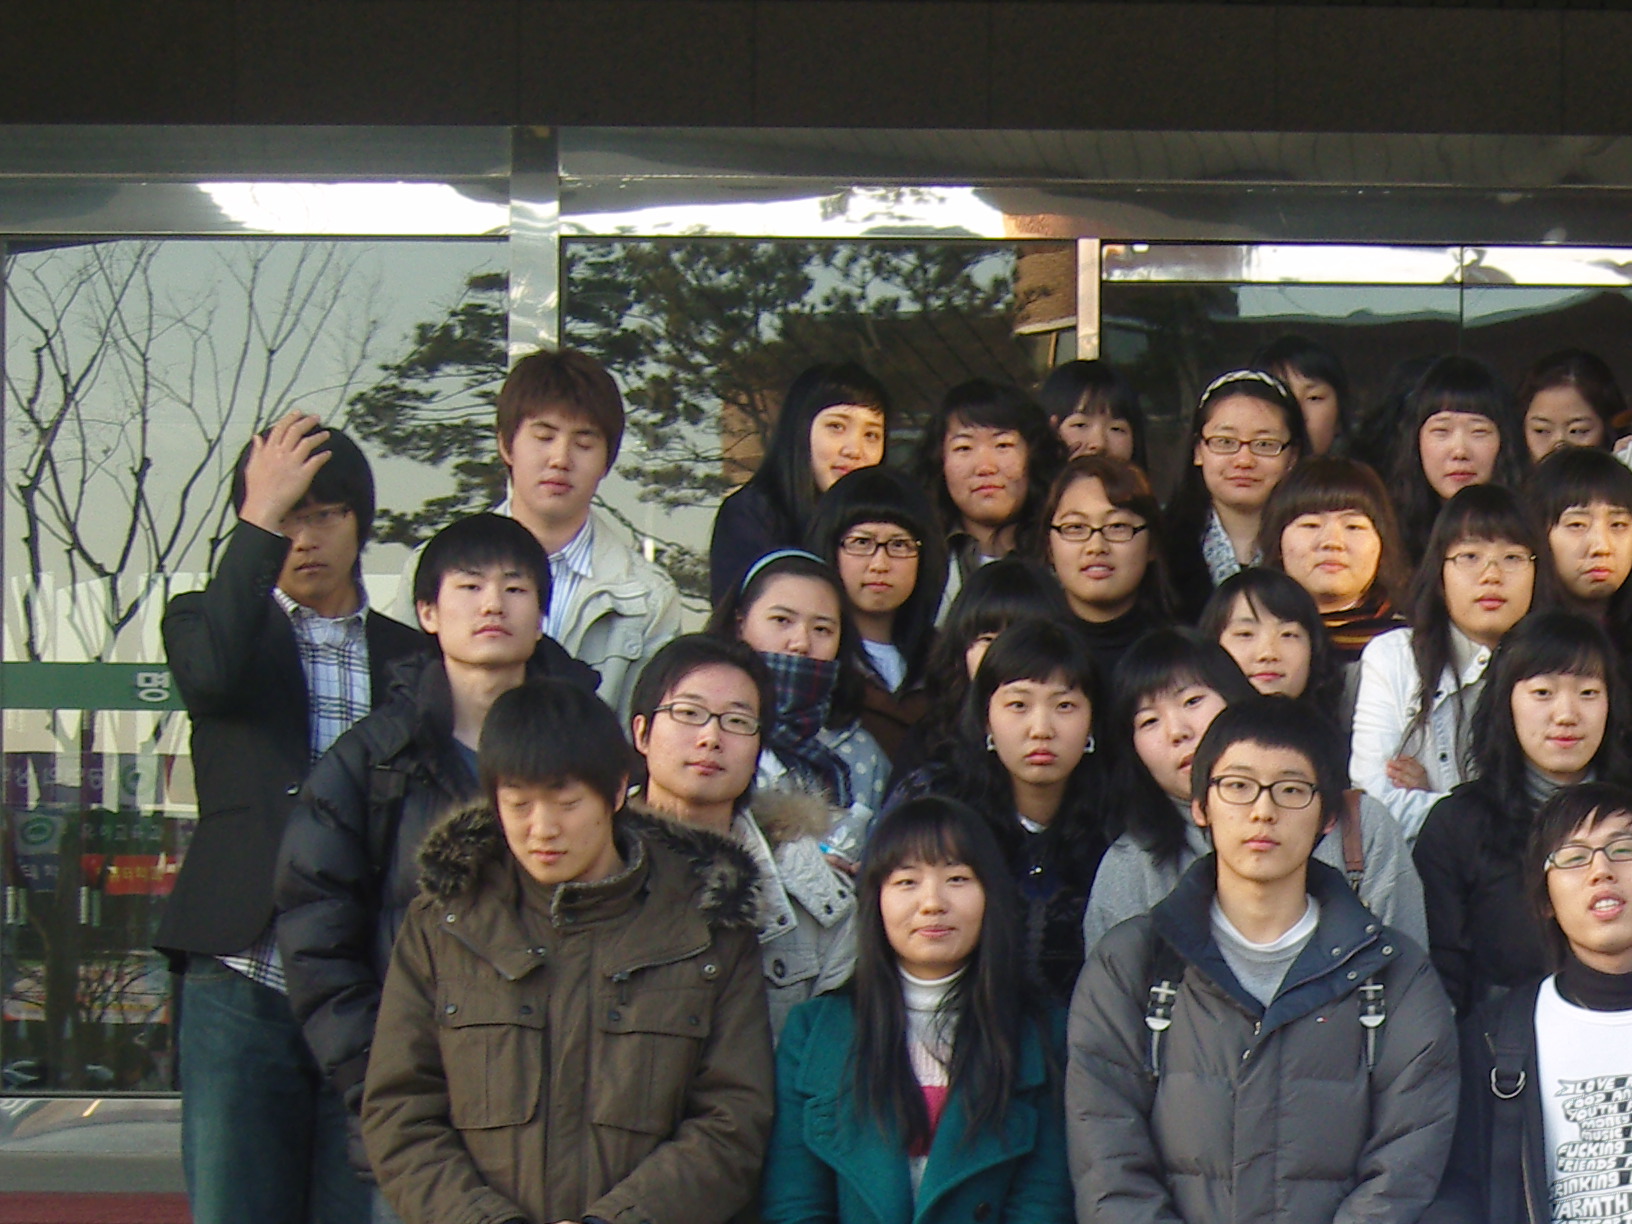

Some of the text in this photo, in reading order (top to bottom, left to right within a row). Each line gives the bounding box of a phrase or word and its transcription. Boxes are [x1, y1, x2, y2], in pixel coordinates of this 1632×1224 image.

[1574, 1077, 1616, 1094] LOVE
[1567, 1103, 1619, 1120] YOUTH
[1550, 1171, 1620, 1197] RINKING
[1552, 1192, 1629, 1219] ARMTH
